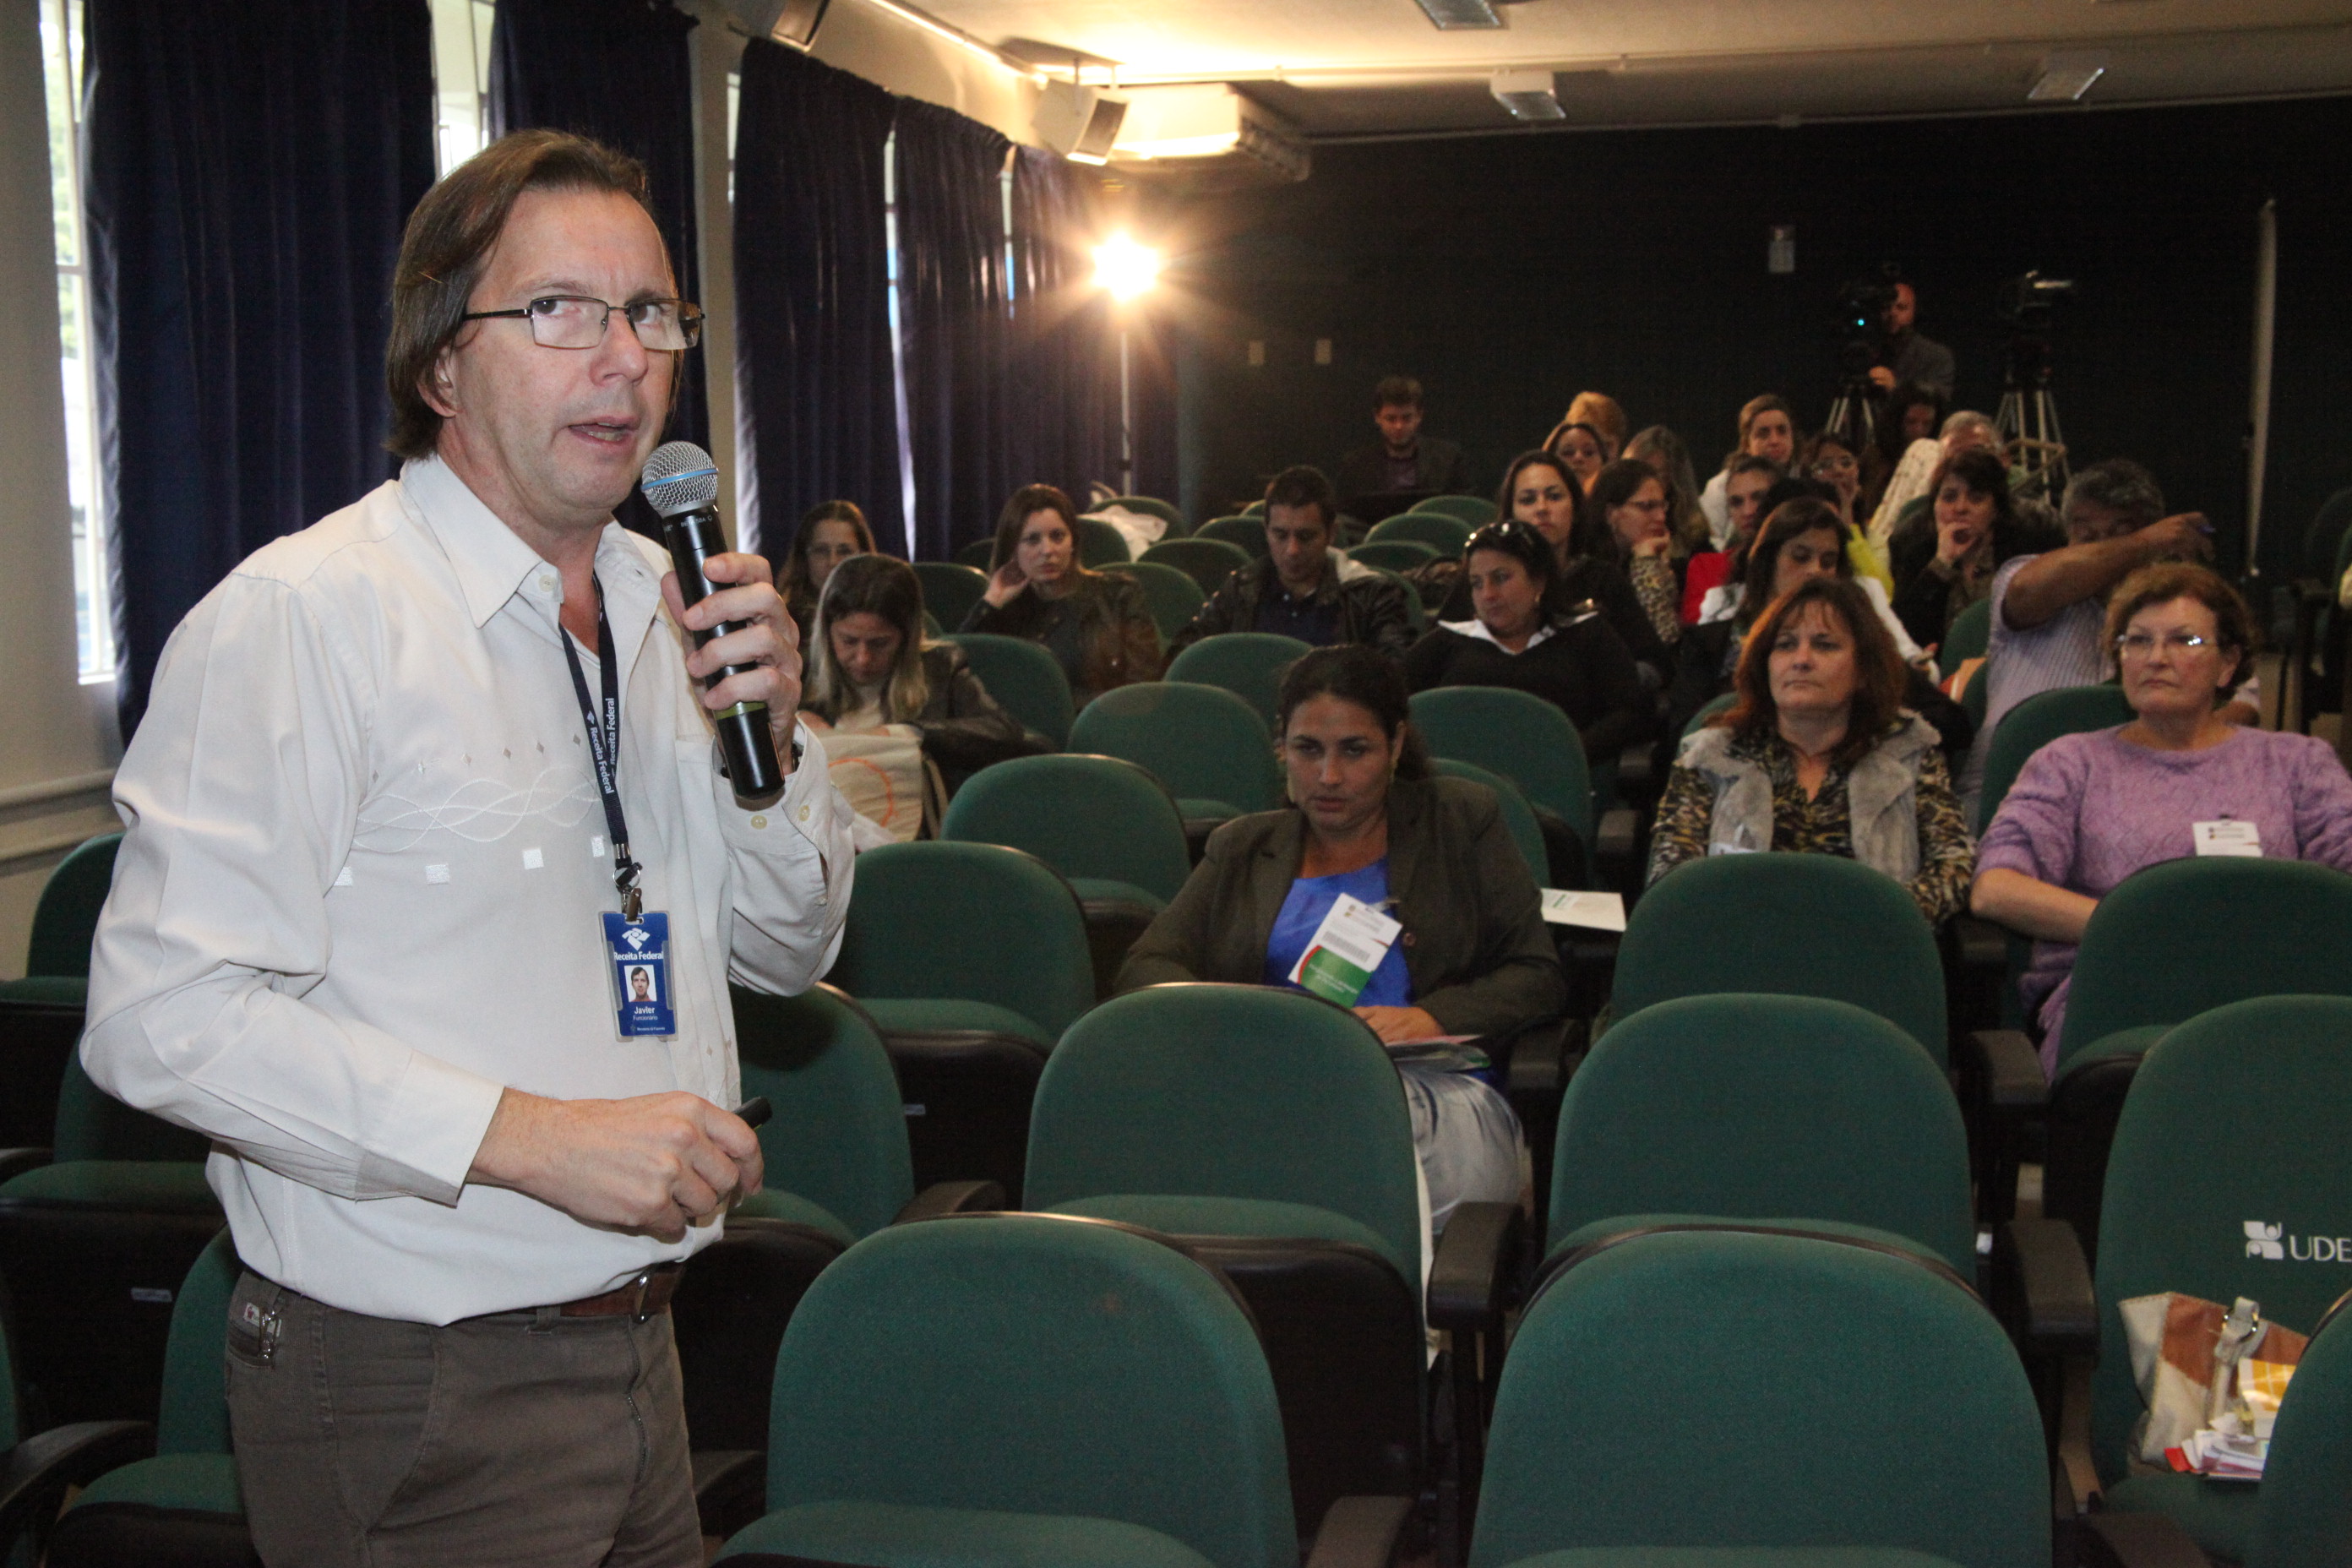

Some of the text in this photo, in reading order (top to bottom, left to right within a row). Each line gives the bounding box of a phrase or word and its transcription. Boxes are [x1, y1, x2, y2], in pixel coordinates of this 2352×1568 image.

[605, 698, 615, 731] Federal
[591, 727, 614, 794] Receita Federal
[613, 950, 664, 961] Receita Federal
[634, 1005, 656, 1015] Javier
[2289, 1235, 2352, 1262] UDE
